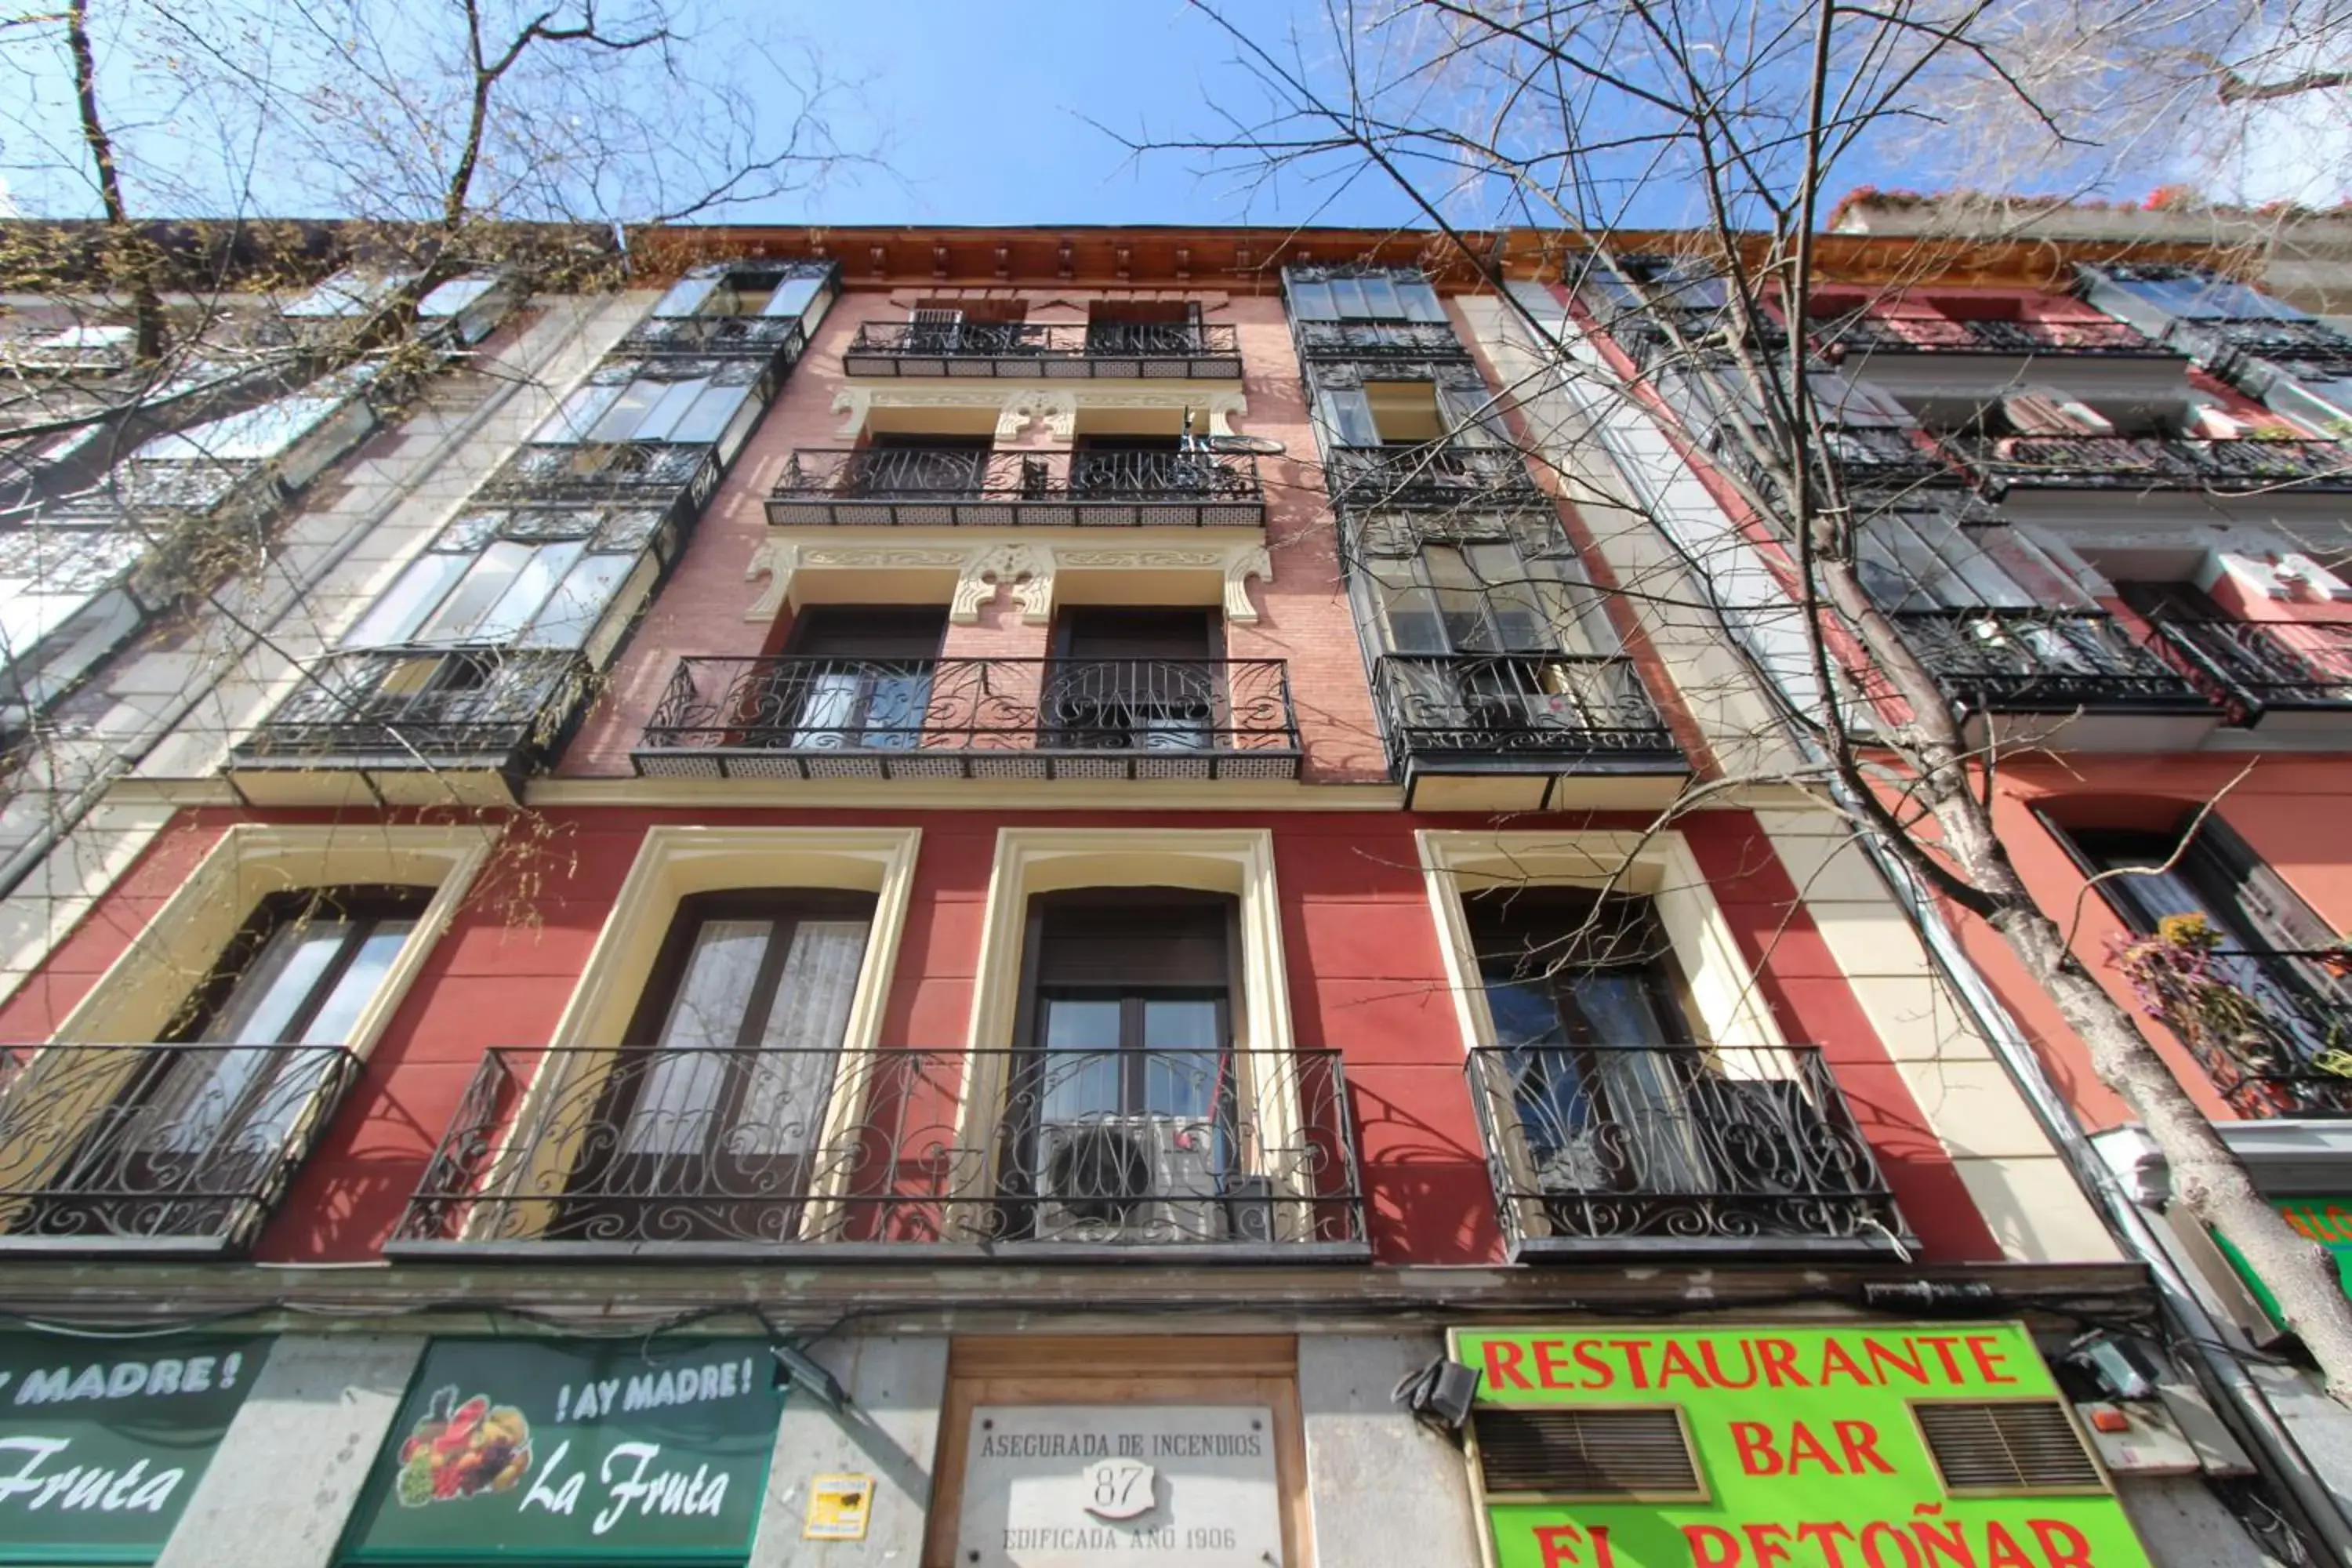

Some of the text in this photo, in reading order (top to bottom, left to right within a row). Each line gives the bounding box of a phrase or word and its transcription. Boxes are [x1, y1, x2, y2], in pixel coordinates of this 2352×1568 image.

[14, 1352, 242, 1405] MADRE!
[622, 1357, 753, 1411] MADRE!
[1481, 1335, 2017, 1390] RESTAURANTE
[980, 1434, 1261, 1457] ASEGURADA DE INCENDIOS
[1729, 1420, 1896, 1476] BAR
[518, 1439, 729, 1536] La Fruta
[1094, 1467, 1143, 1506] 87
[1003, 1524, 1236, 1550] EDIFICADA AÑO 1906
